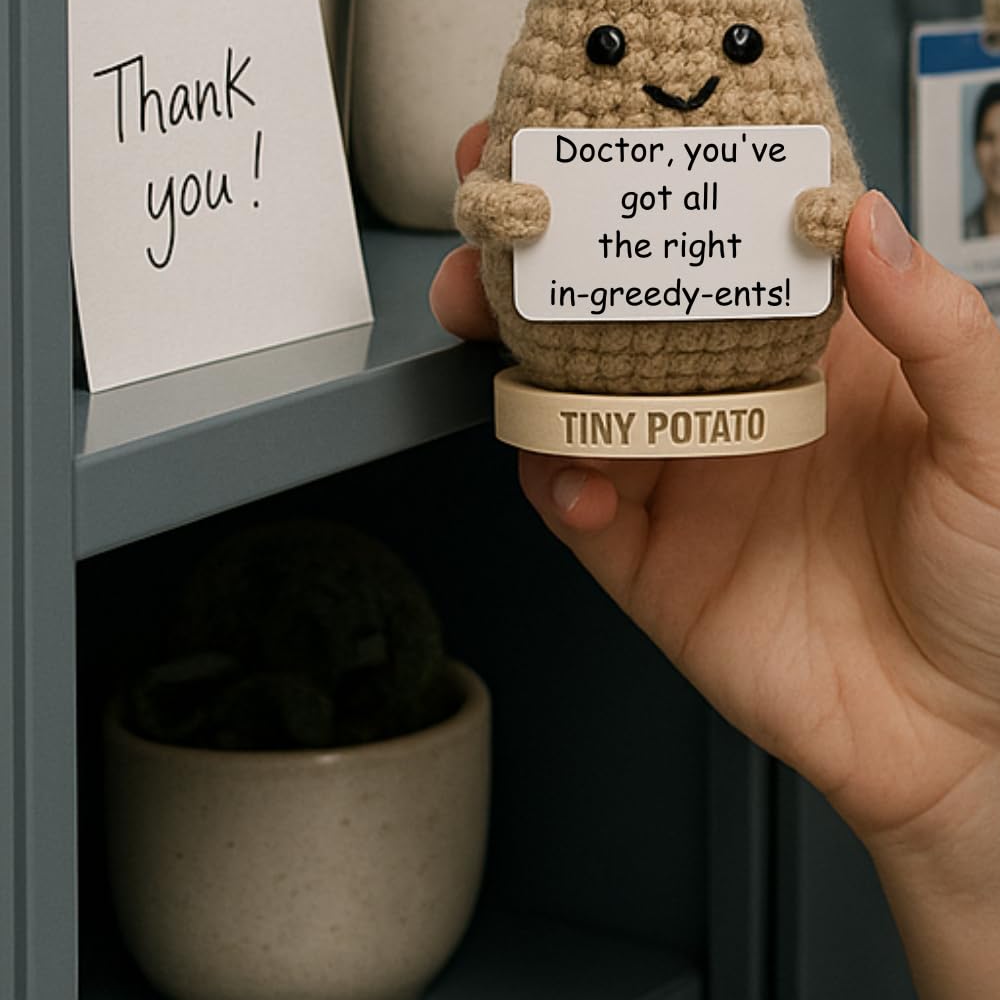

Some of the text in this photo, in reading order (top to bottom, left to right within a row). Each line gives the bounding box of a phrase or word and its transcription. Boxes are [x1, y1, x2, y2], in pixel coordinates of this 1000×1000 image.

[93, 47, 256, 143] Thank
[556, 132, 787, 171] Doctor, you've
[621, 181, 718, 219] got all
[598, 229, 742, 267] the right
[550, 278, 791, 316] in-greedy-ents!
[559, 407, 765, 446] TINY POTATO
